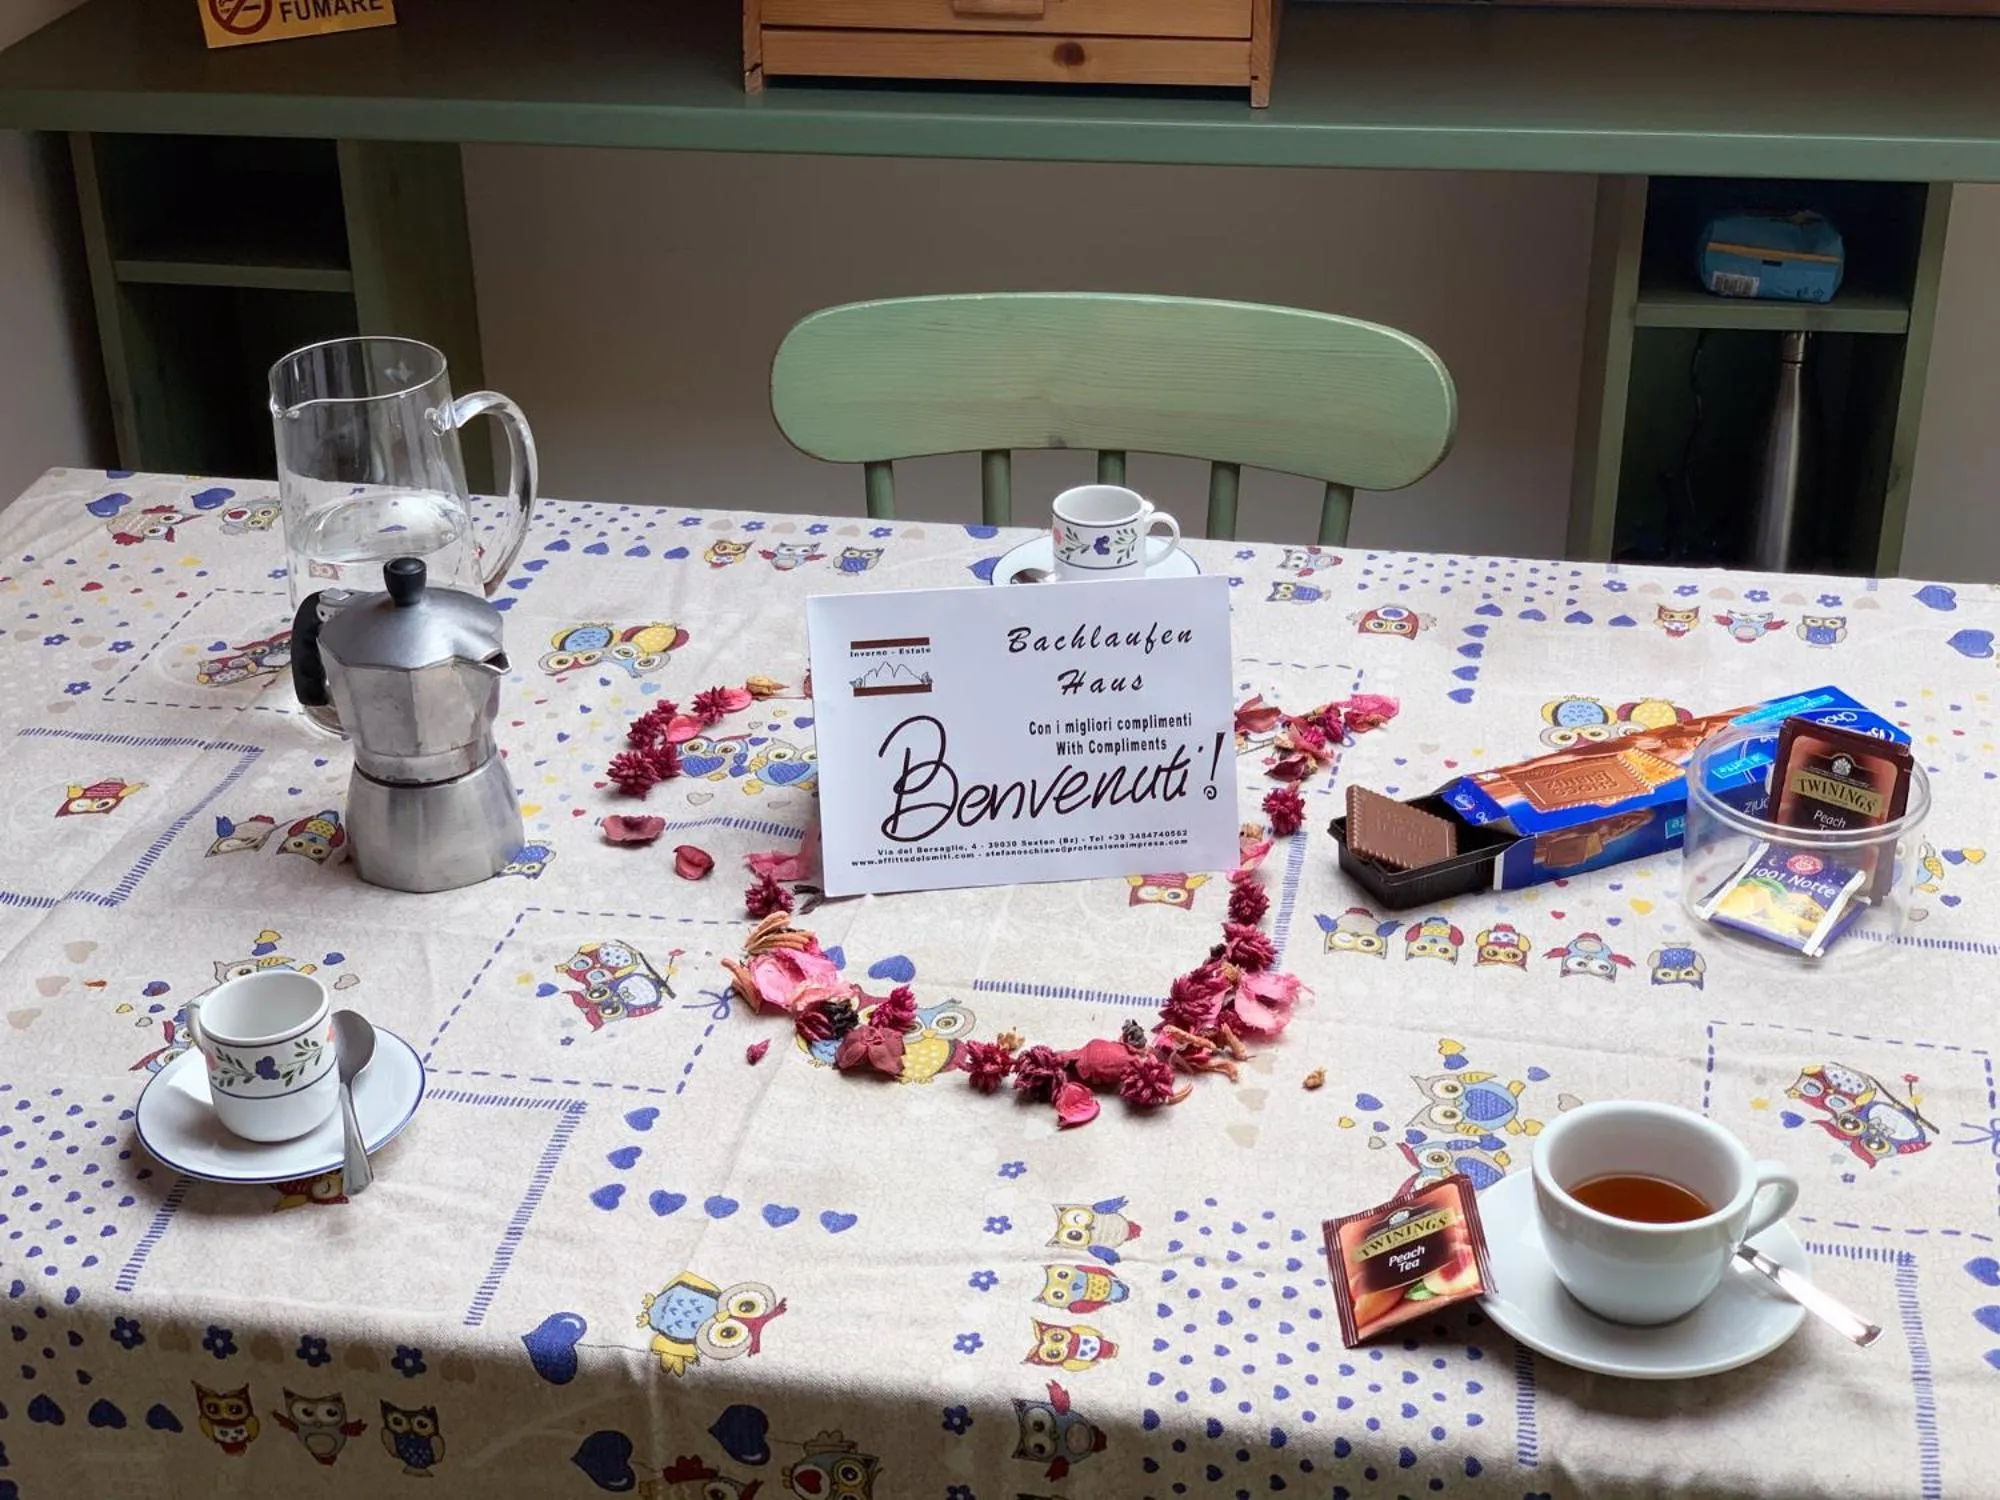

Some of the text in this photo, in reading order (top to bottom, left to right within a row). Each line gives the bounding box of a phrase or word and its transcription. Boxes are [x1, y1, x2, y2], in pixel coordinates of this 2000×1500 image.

[1007, 621, 1193, 655] Bachlaufen
[849, 650, 888, 658] Inverno
[899, 647, 932, 655] Estate
[1057, 668, 1144, 696] Haus
[1028, 712, 1193, 736] Con i migliori complimenti
[1056, 737, 1168, 756] With Compliments
[1798, 777, 1878, 814] TWININGS
[1812, 808, 1847, 829] Peach
[877, 848, 894, 857] Via
[897, 846, 913, 856] del
[1089, 834, 1104, 843] Tel
[1750, 867, 1837, 899] 1001 Notte
[1358, 1214, 1450, 1258] TWININGS
[1388, 1244, 1426, 1267] Peach
[1398, 1260, 1420, 1273] Tea
